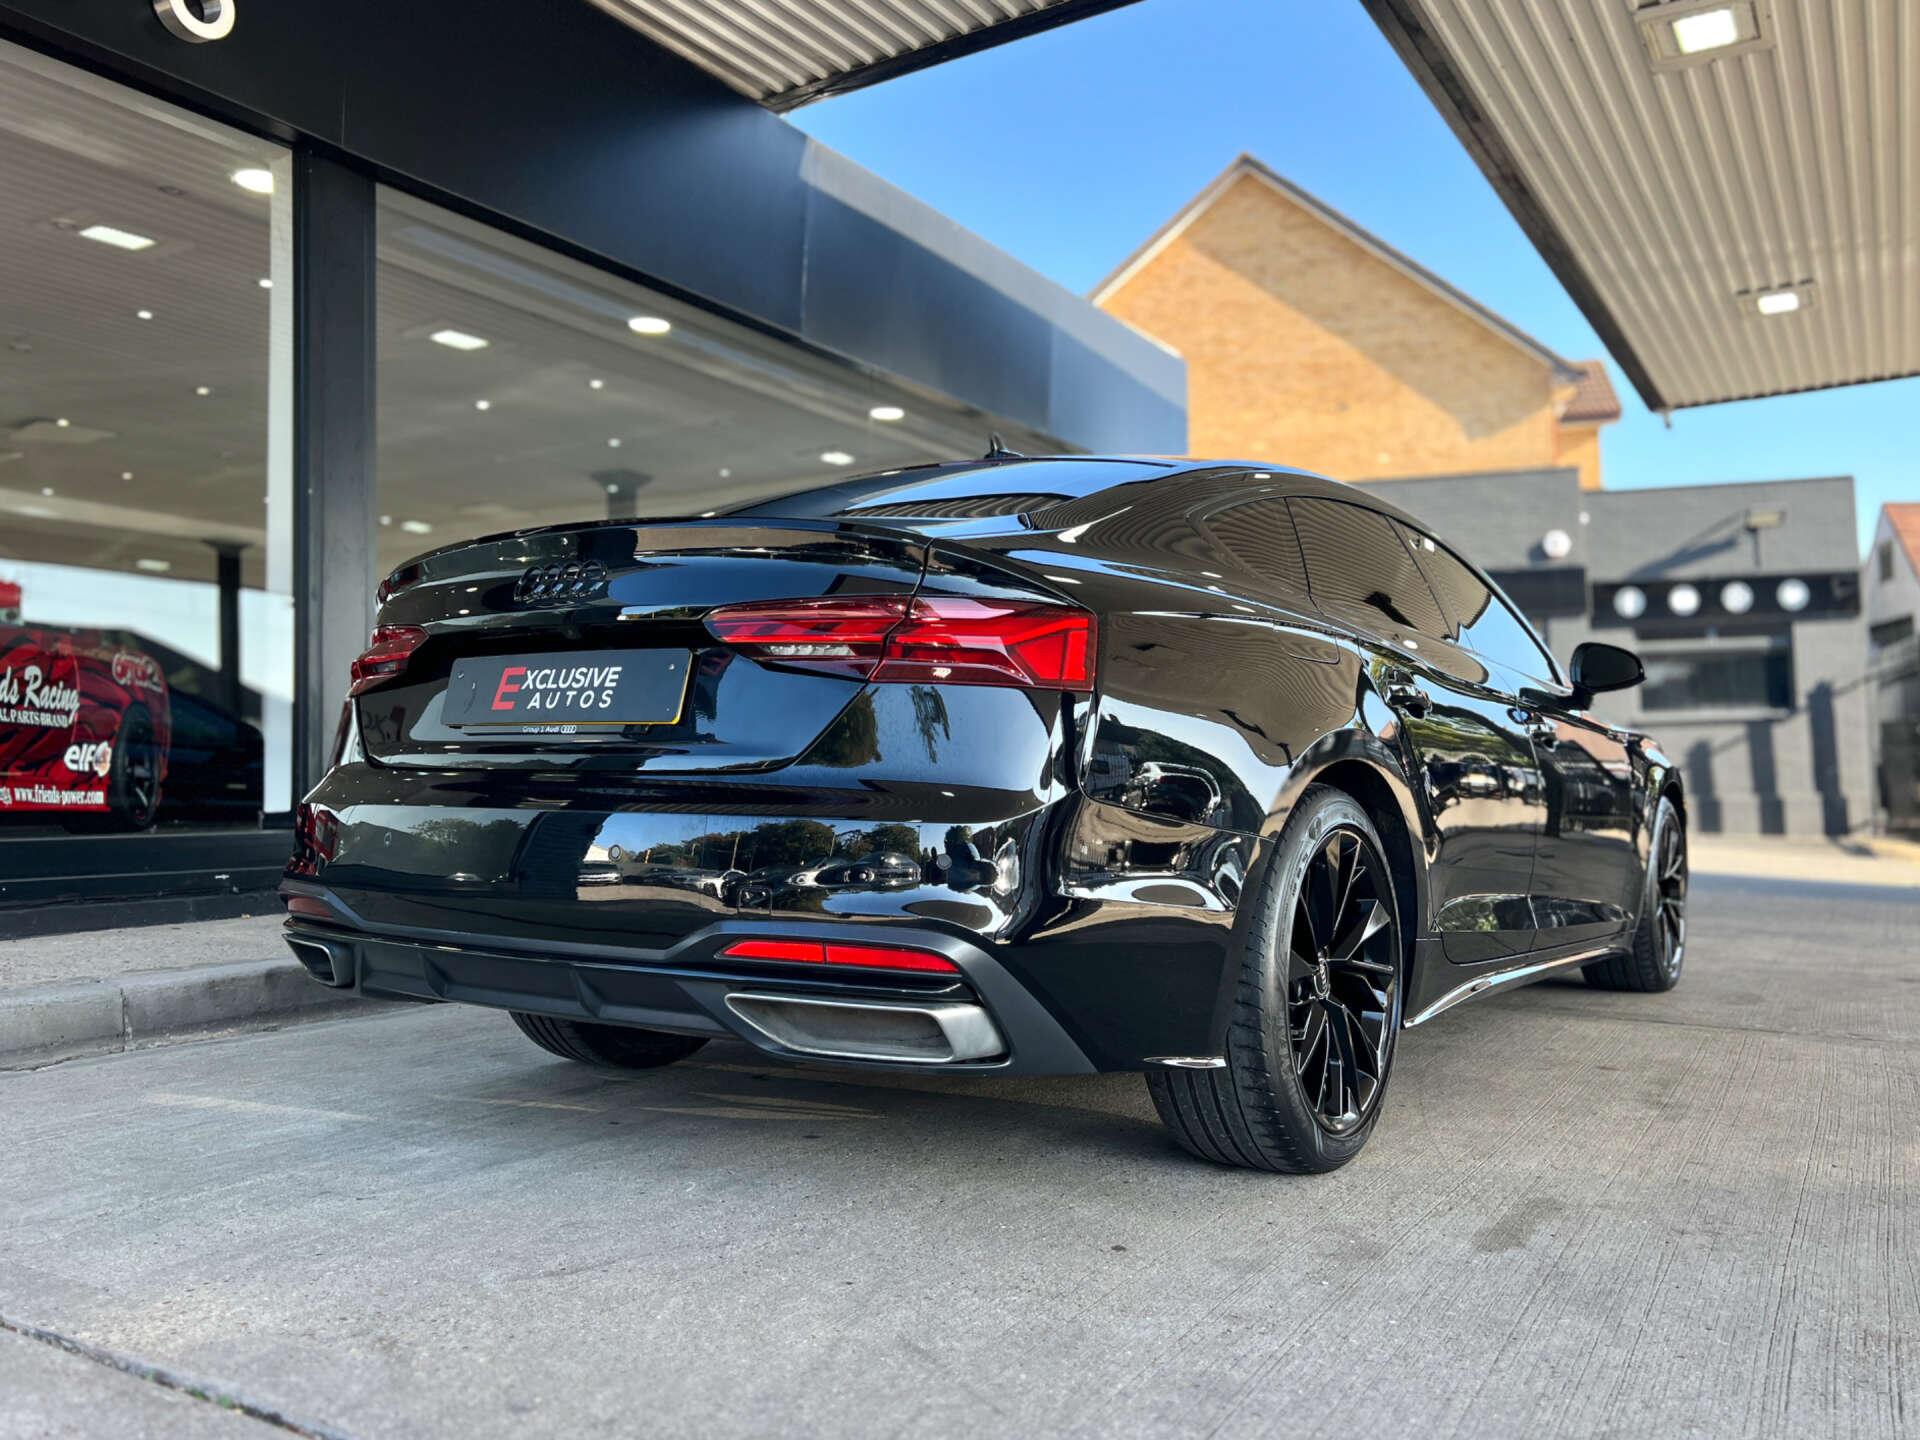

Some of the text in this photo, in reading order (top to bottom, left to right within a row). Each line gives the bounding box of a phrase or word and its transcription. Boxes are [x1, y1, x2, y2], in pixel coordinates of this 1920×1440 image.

[24, 665, 80, 725] Racing
[491, 666, 622, 710] EXCLUSIVE
[526, 689, 614, 710] AUTOS
[10, 708, 40, 725] PARTS
[40, 712, 69, 728] BRAND
[64, 743, 98, 772] elf
